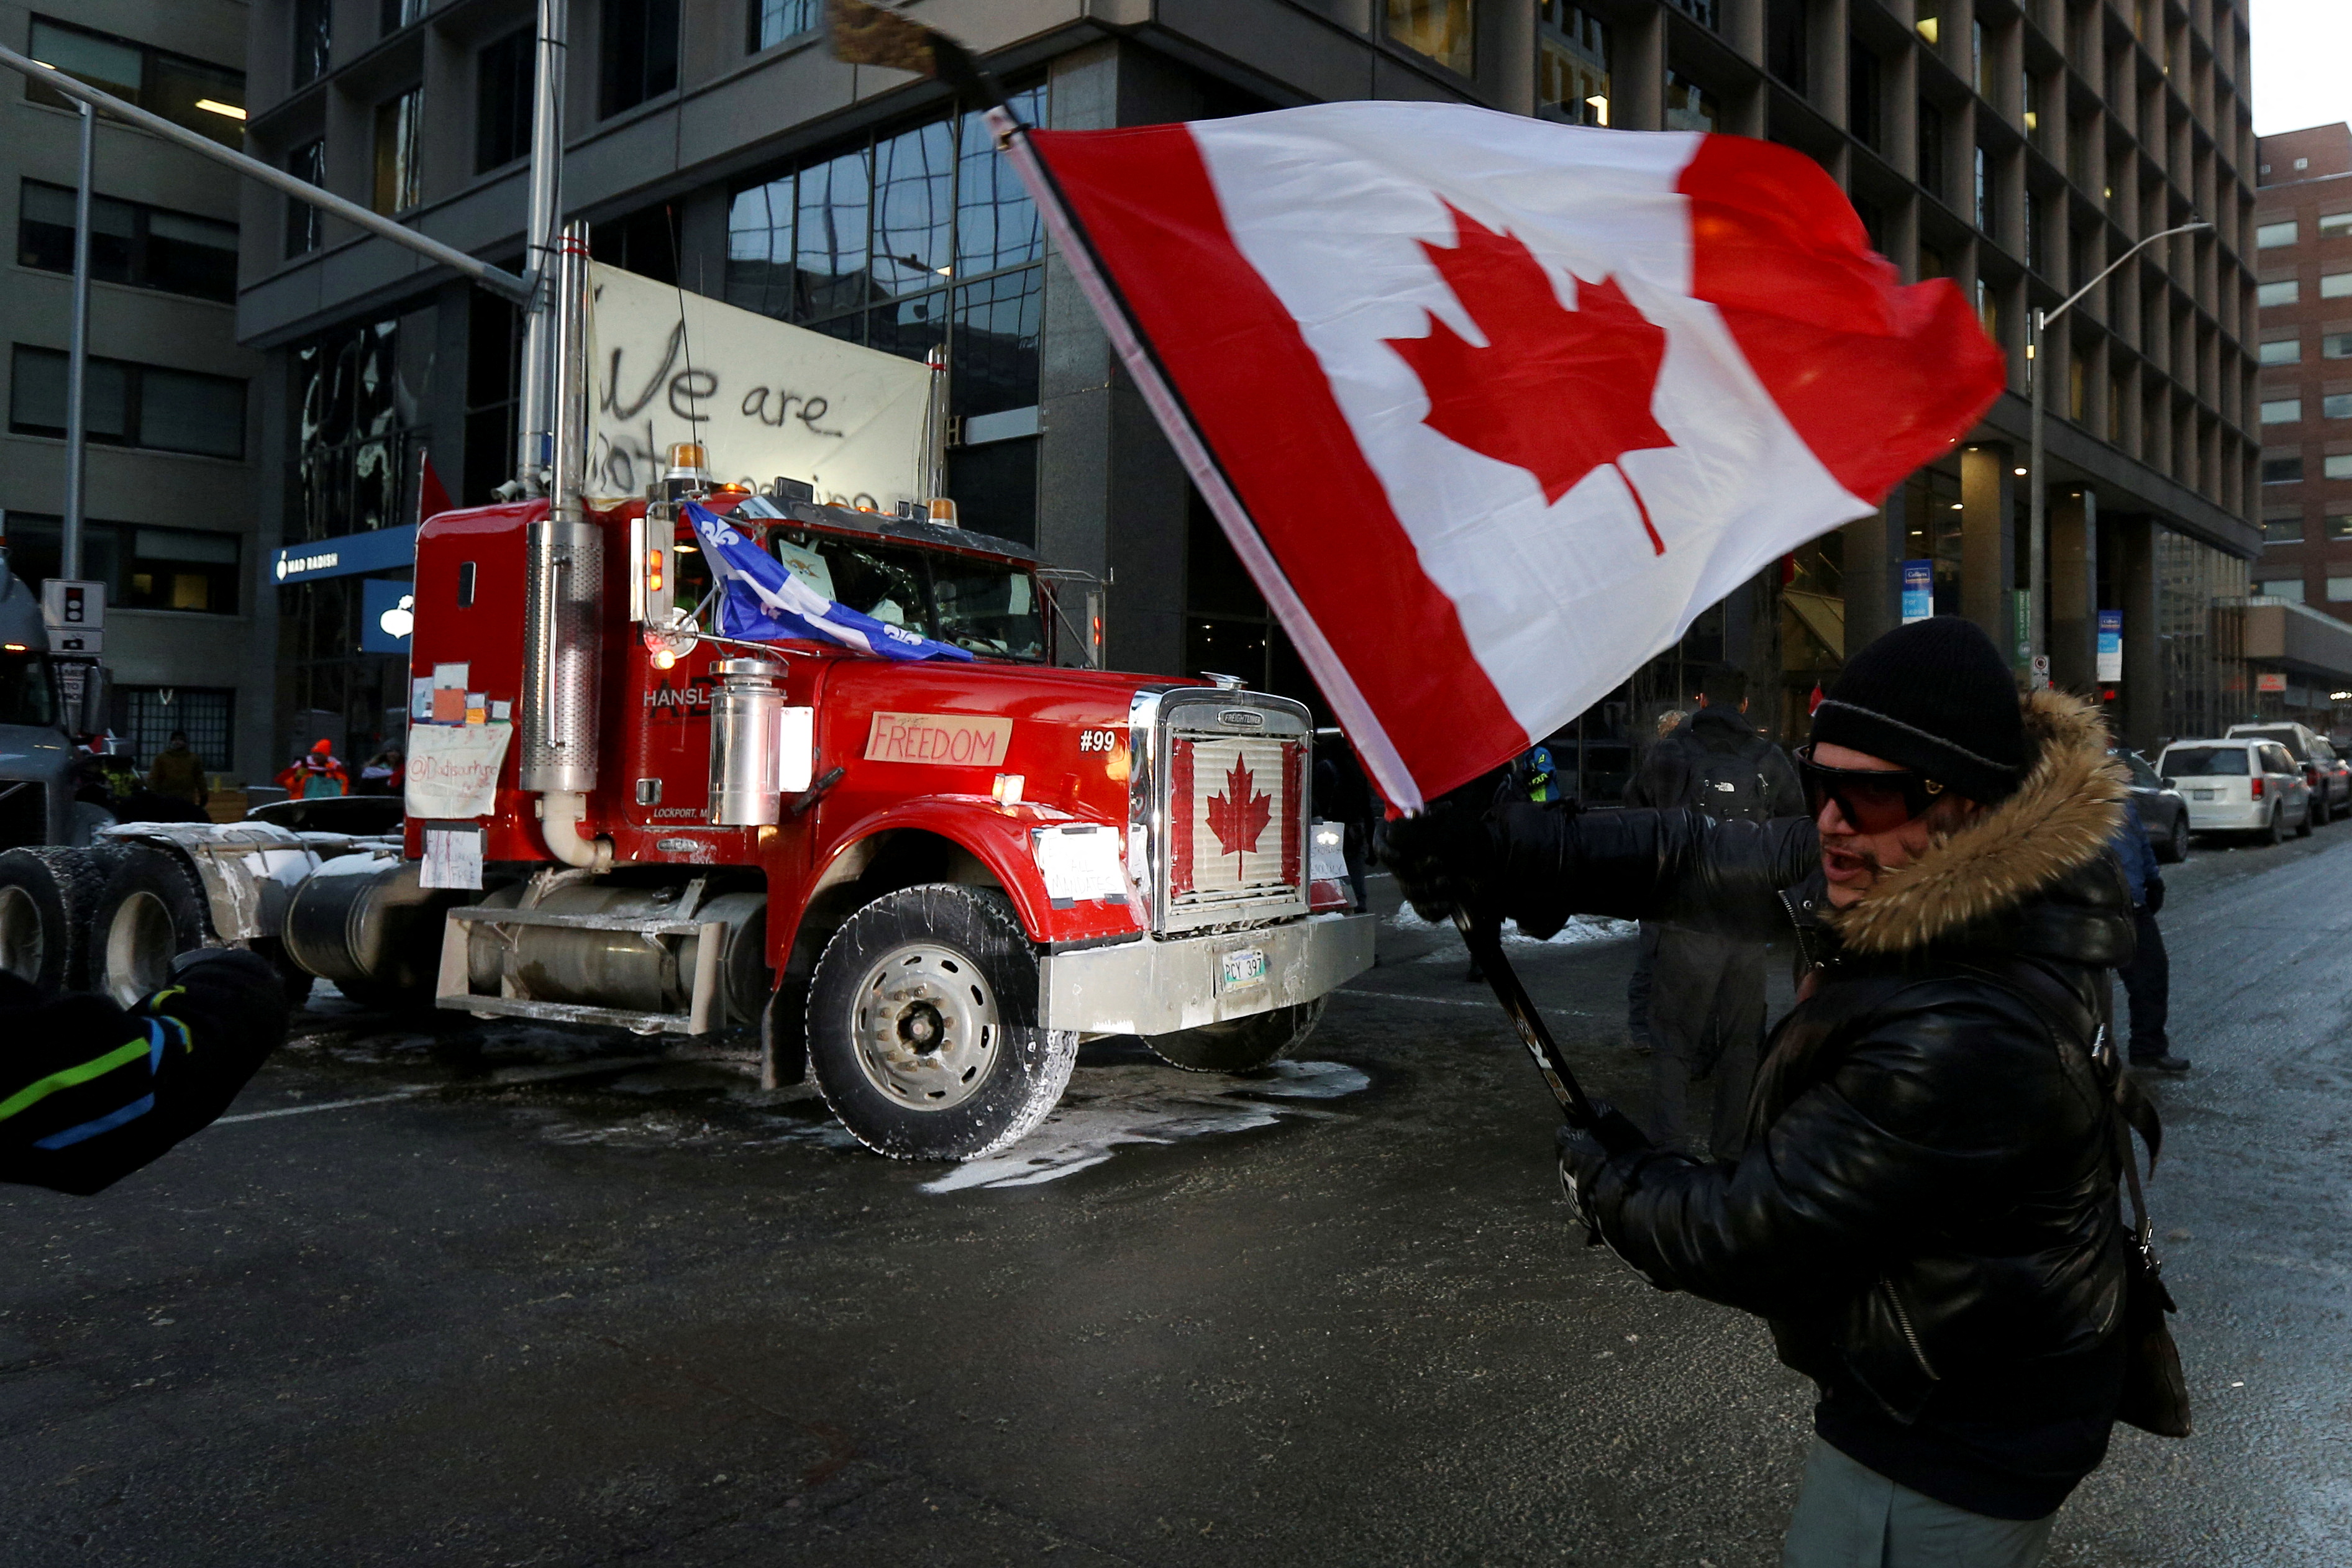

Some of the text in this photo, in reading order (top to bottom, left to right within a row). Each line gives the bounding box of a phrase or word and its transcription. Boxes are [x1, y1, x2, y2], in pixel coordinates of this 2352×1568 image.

[742, 386, 844, 437] are
[288, 552, 338, 573] MAD RADISH
[872, 716, 996, 762] FREEDOM
[1080, 729, 1116, 752] #99
[654, 808, 698, 818] LOCKPORT,
[1072, 860, 1094, 872] ALL
[1052, 873, 1118, 896] MANDATES
[1225, 958, 1262, 981] PCY 397
